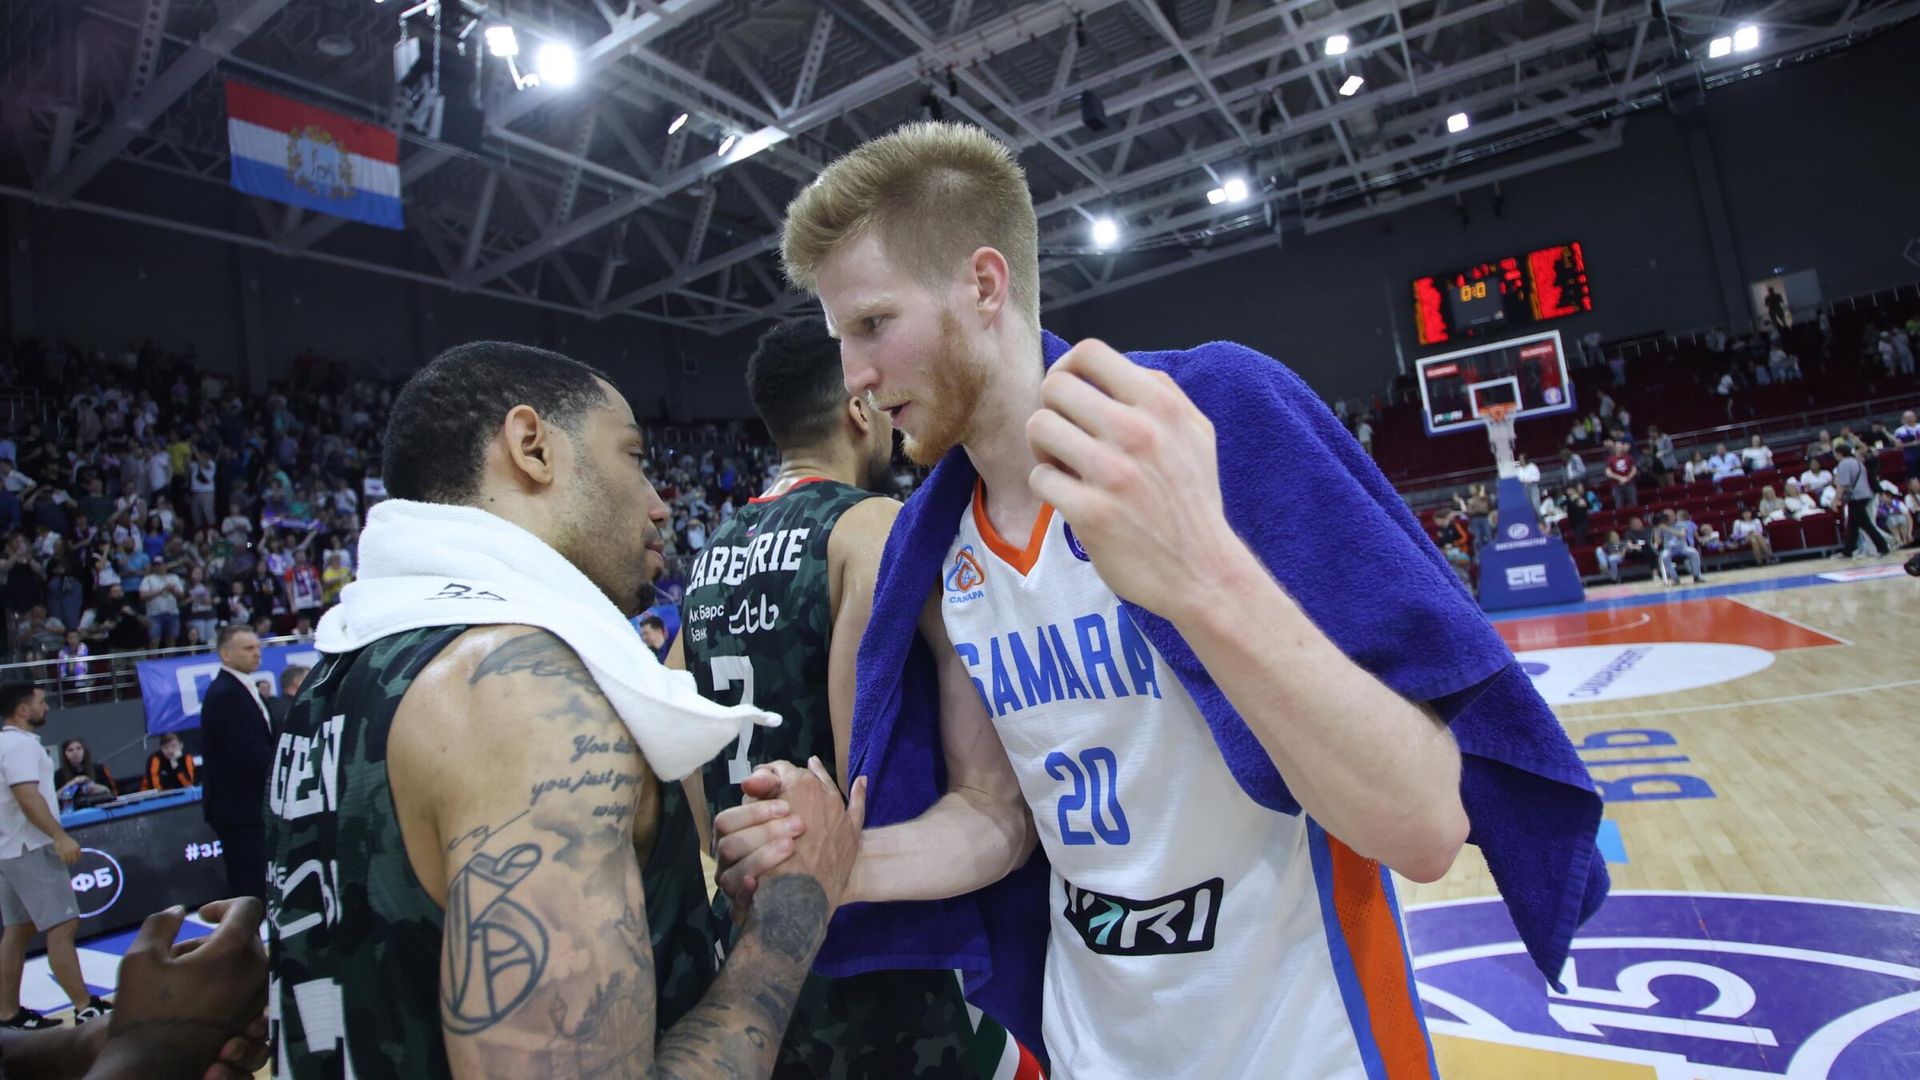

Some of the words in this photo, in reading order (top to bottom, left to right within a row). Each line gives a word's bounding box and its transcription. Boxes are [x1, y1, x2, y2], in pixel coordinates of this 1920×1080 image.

[685, 527, 810, 596] LABERIE
[699, 604, 725, 621] Барс
[710, 655, 754, 784] 7
[570, 735, 610, 763] You
[530, 777, 571, 806] you
[569, 769, 614, 793] just
[1044, 746, 1130, 845] 20
